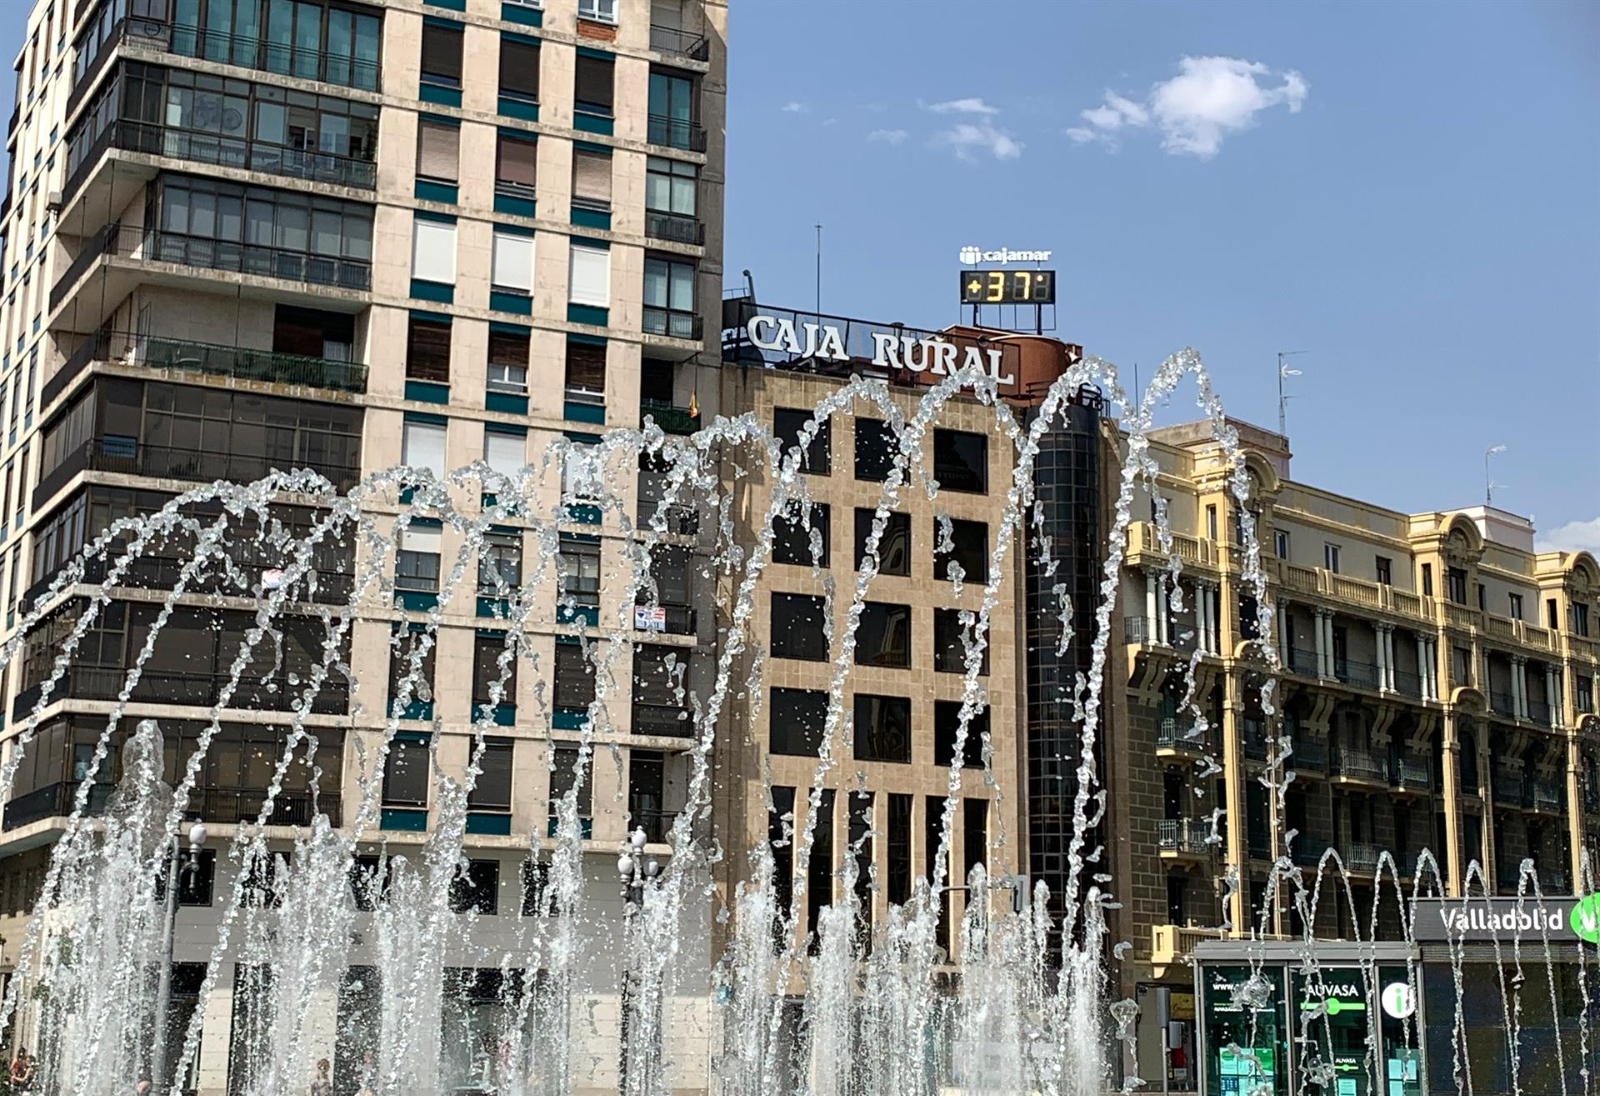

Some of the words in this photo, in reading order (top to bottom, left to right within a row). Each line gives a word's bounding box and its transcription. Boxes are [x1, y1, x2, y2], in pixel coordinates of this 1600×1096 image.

[983, 247, 1052, 265] cajamar
[747, 315, 851, 361] CAJA
[871, 331, 1014, 386] RURAL
[1439, 907, 1564, 931] Valladolid
[1307, 983, 1359, 997] AUVASA
